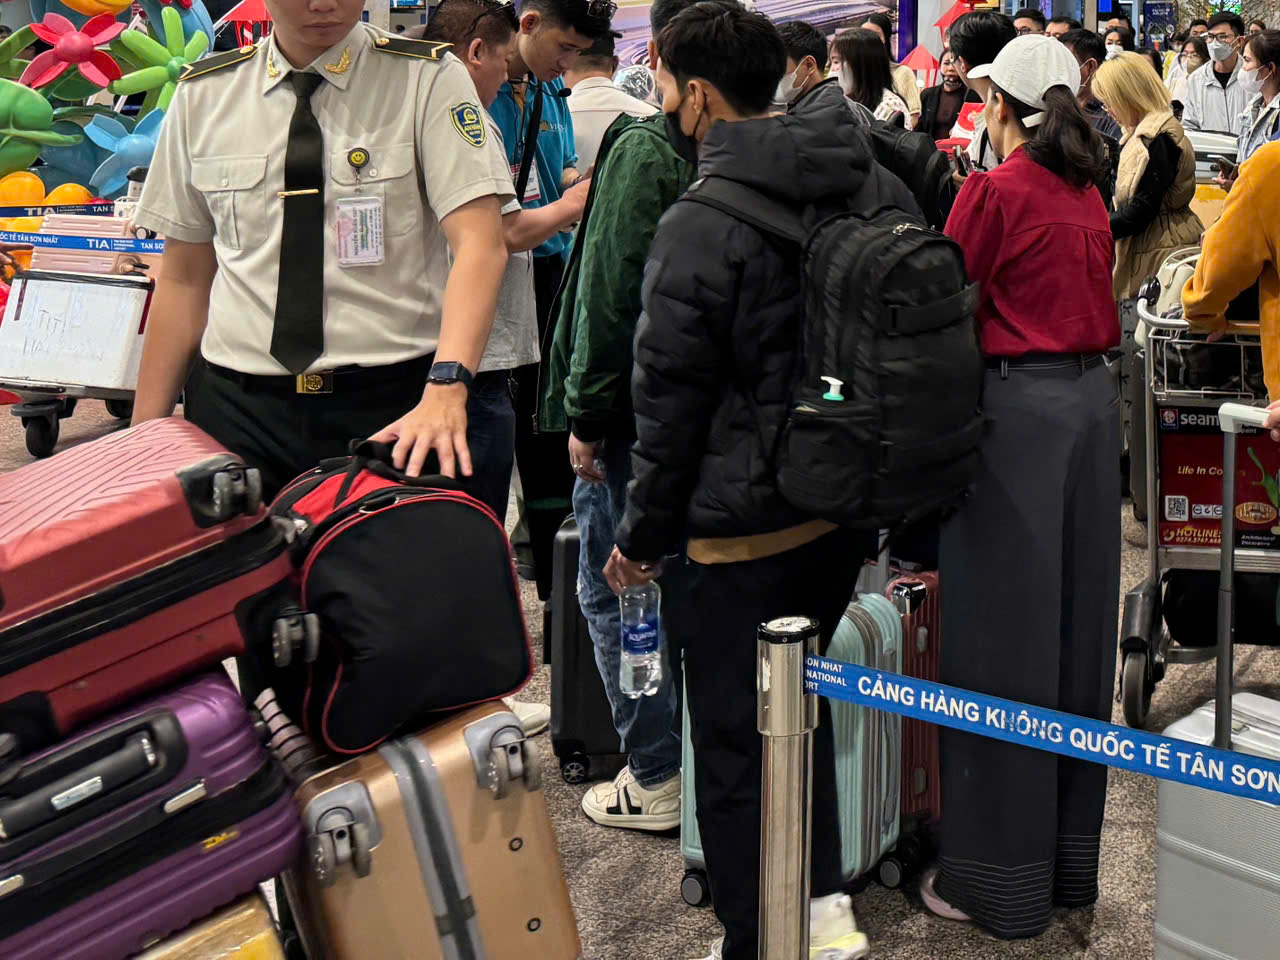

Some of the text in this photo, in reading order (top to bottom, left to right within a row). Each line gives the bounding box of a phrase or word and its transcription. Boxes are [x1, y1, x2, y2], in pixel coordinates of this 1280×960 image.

[86, 238, 110, 249] TIA
[1177, 465, 1194, 475] Life
[1196, 466, 1206, 475] In
[1175, 526, 1222, 538] HOTLINE:
[820, 660, 843, 673] NHAT
[858, 673, 914, 706] CẢNG
[920, 688, 980, 723] HÀNG
[985, 707, 1063, 743] KHÔNG
[1069, 728, 1135, 761] QUỐC
[1141, 742, 1170, 769] TẾ
[1176, 752, 1225, 781] TÂN
